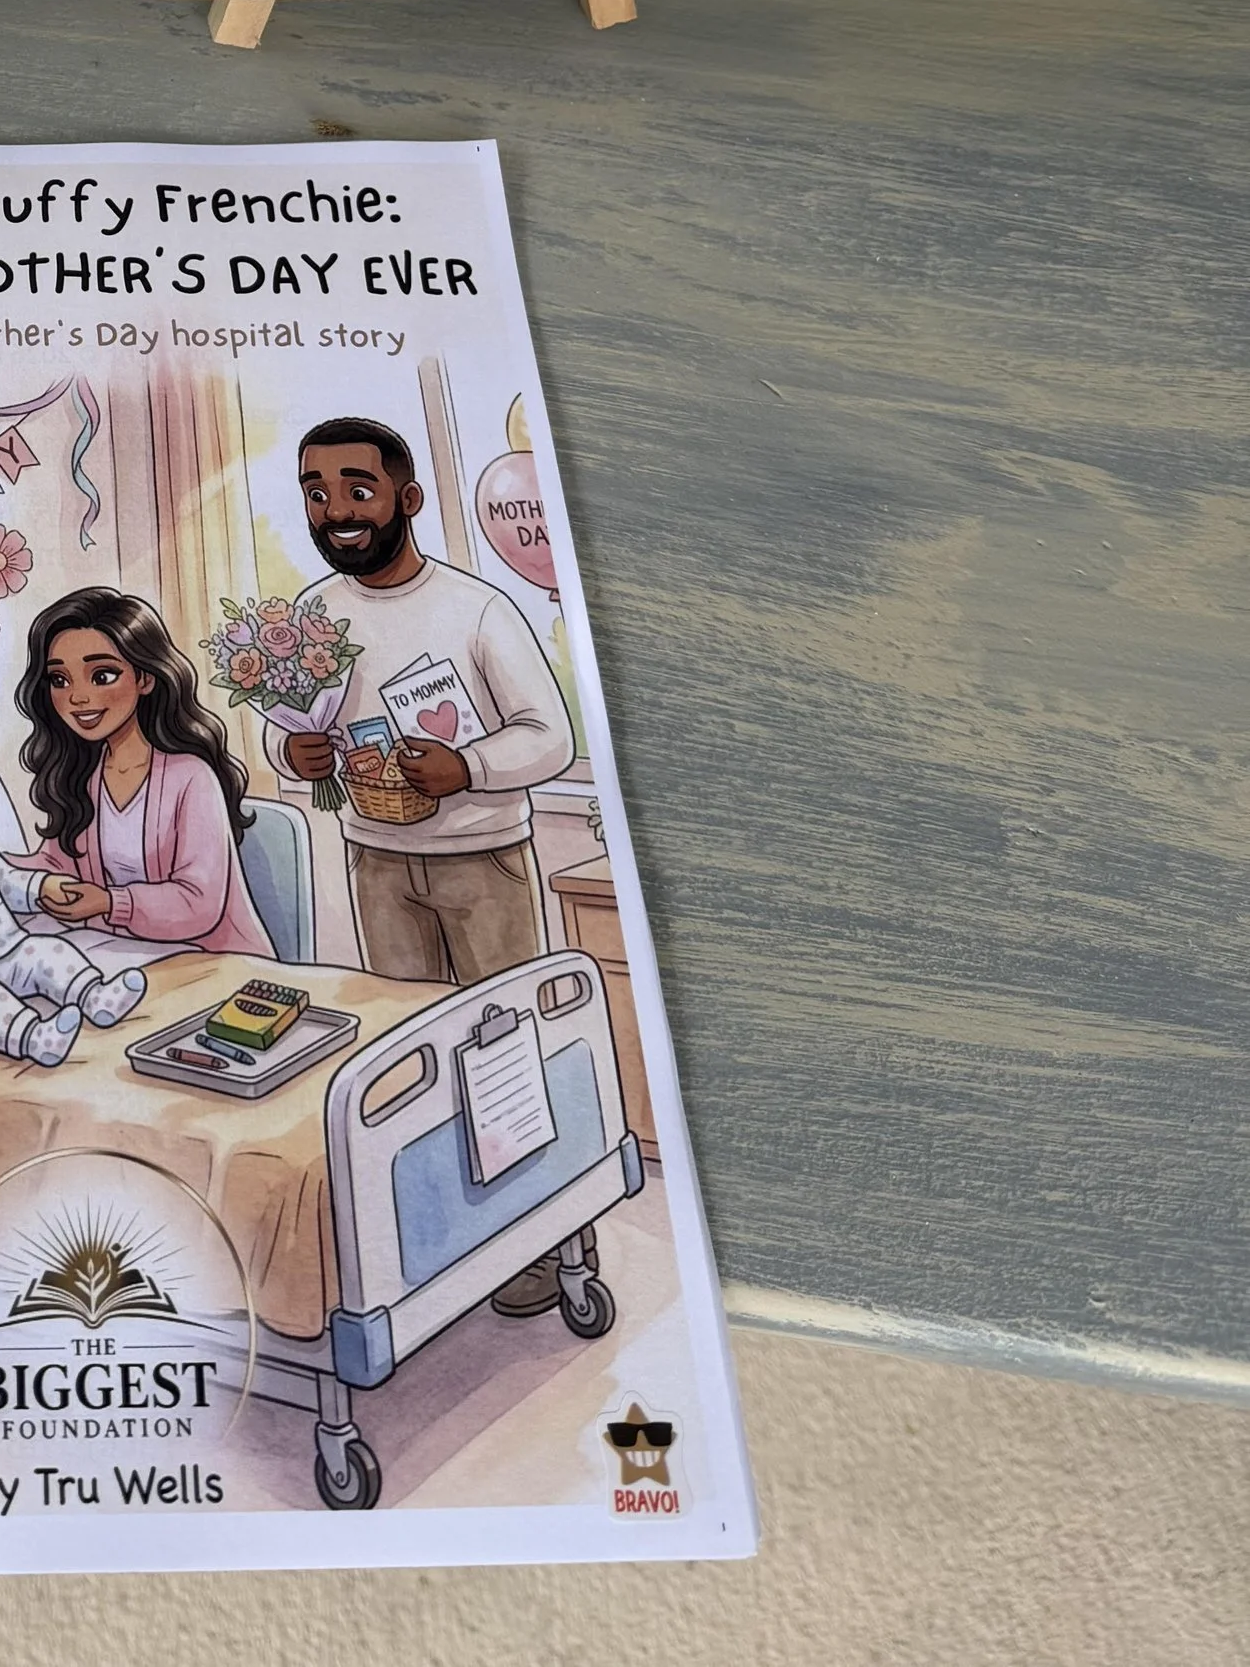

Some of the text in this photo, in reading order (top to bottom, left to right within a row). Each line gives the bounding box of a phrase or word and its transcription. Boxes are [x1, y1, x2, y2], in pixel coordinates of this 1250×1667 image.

[155, 180, 403, 226] Frenchie:
[231, 253, 339, 296] DAY
[363, 250, 478, 296] EVER
[96, 322, 159, 354] Day
[171, 319, 304, 358] hospital
[317, 323, 407, 358] story
[488, 500, 544, 521] MOTH
[517, 524, 550, 547] DA
[389, 674, 456, 710] TO MOMMY
[71, 1338, 116, 1356] THE
[2, 1418, 192, 1439] FOUNDATION
[34, 1467, 99, 1506] Tru
[114, 1463, 223, 1505] Wells
[614, 1489, 680, 1514] BRAVO!
